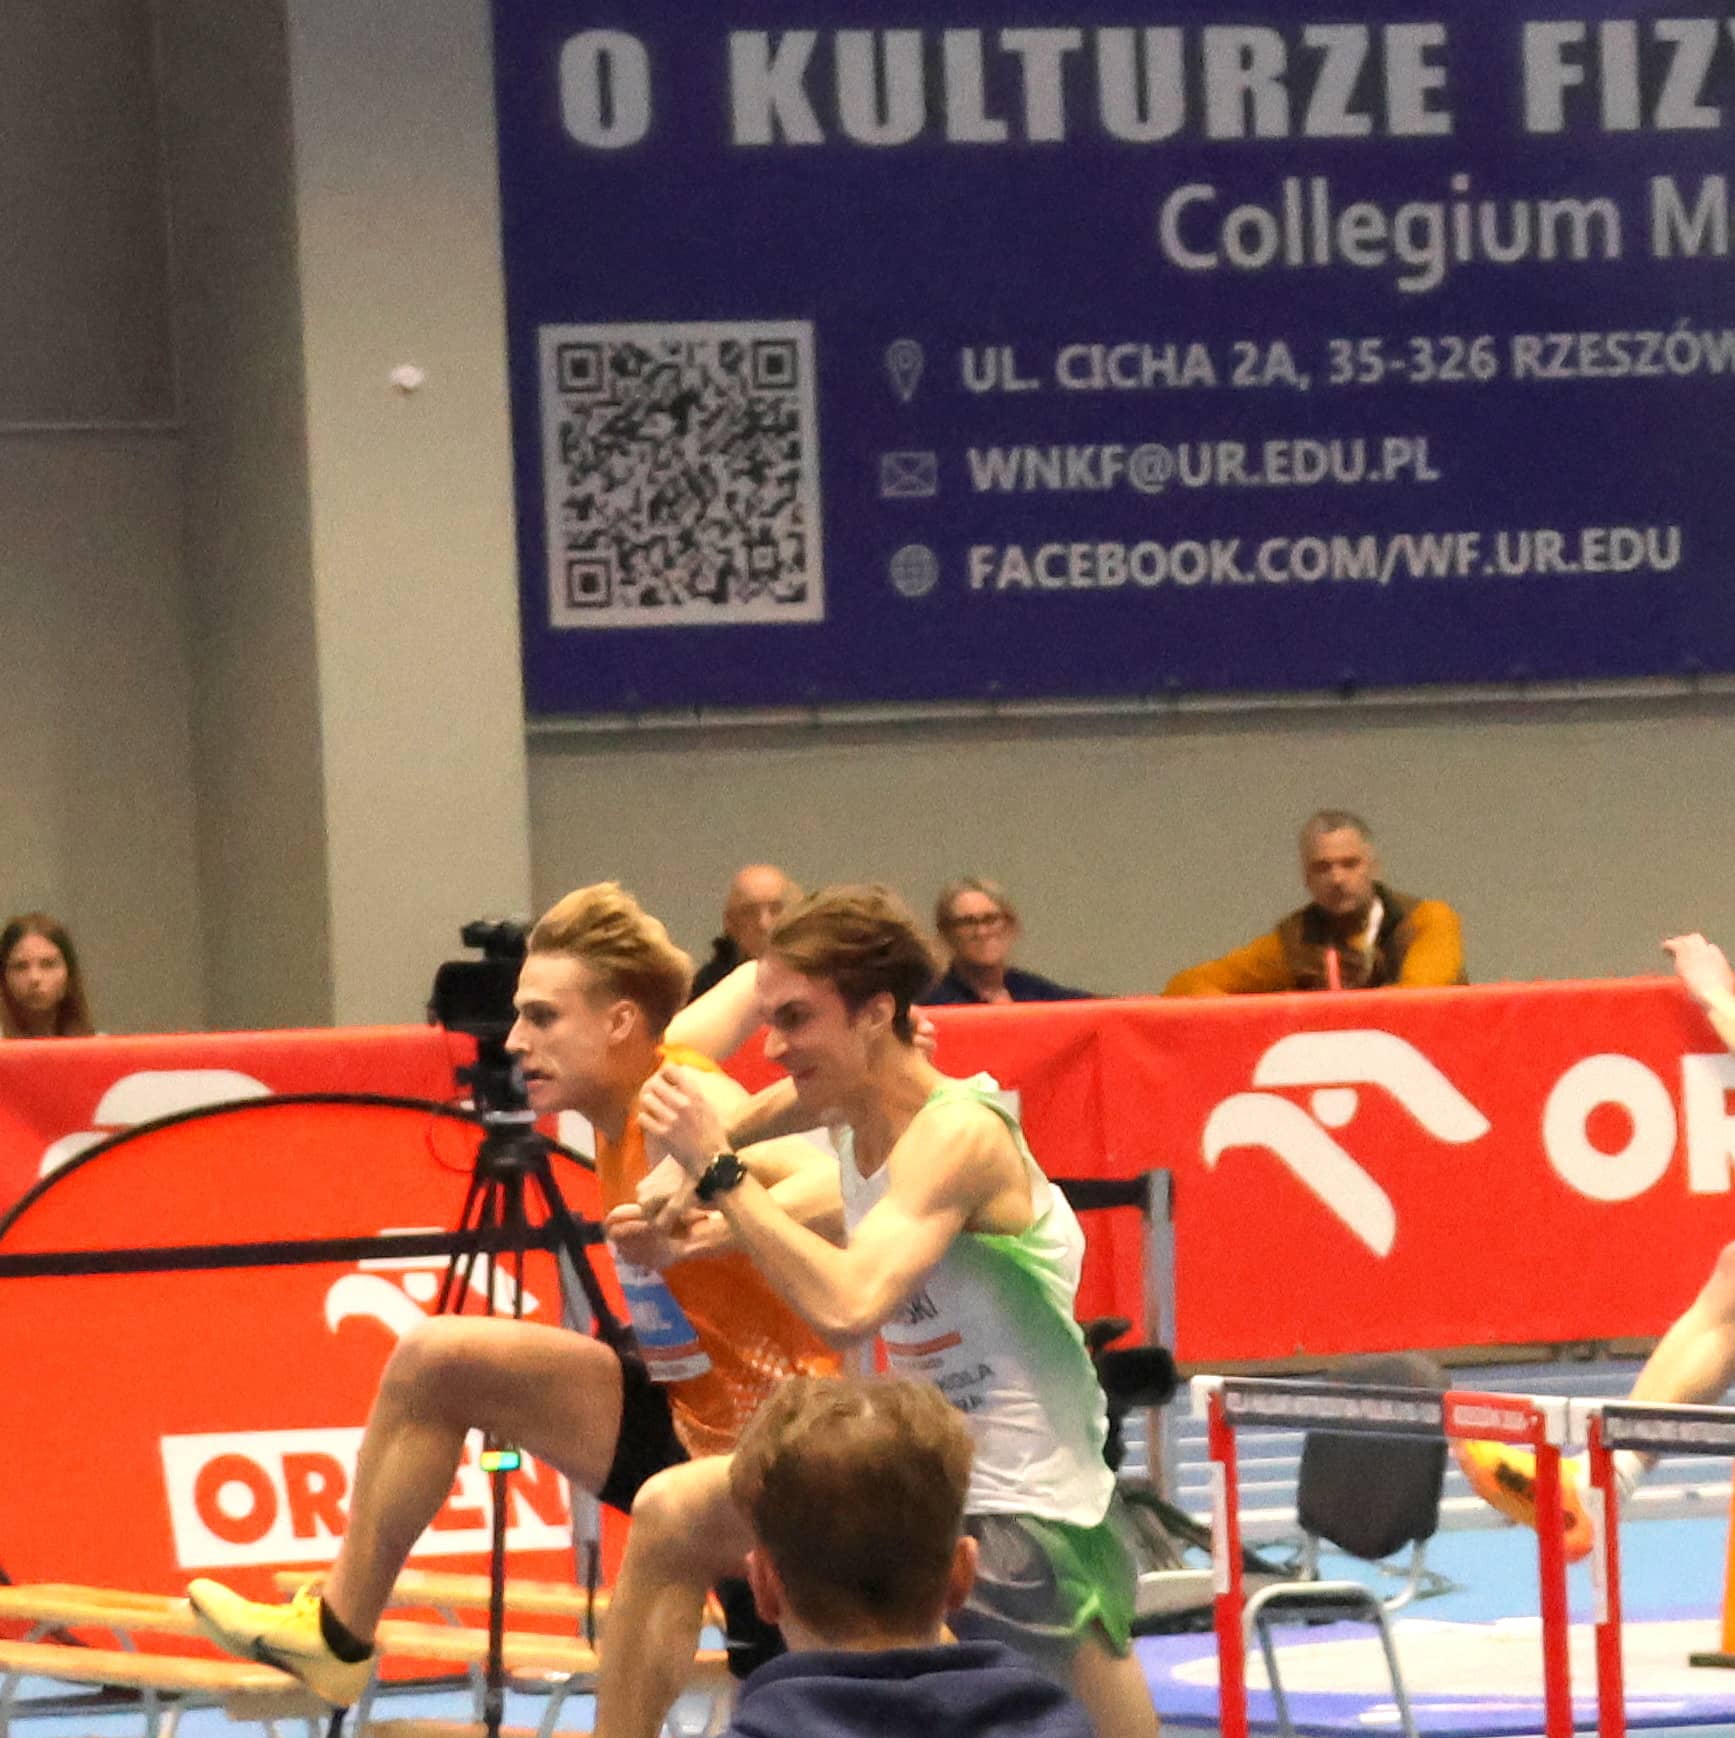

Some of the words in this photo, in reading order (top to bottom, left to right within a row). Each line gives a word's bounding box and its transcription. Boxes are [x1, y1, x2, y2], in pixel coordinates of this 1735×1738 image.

[558, 28, 651, 148] O
[728, 23, 1453, 147] KULTURZE
[1158, 176, 1621, 293] Collegium
[962, 348, 1039, 392] UL.
[1056, 344, 1217, 390] CICHA
[1231, 341, 1310, 391] 2A,
[1328, 334, 1498, 383] 35-326
[967, 436, 1438, 494] WNKF@UR.EDU.PL
[968, 525, 1681, 591] FACEBOOK.COM/WF.UR.EDU
